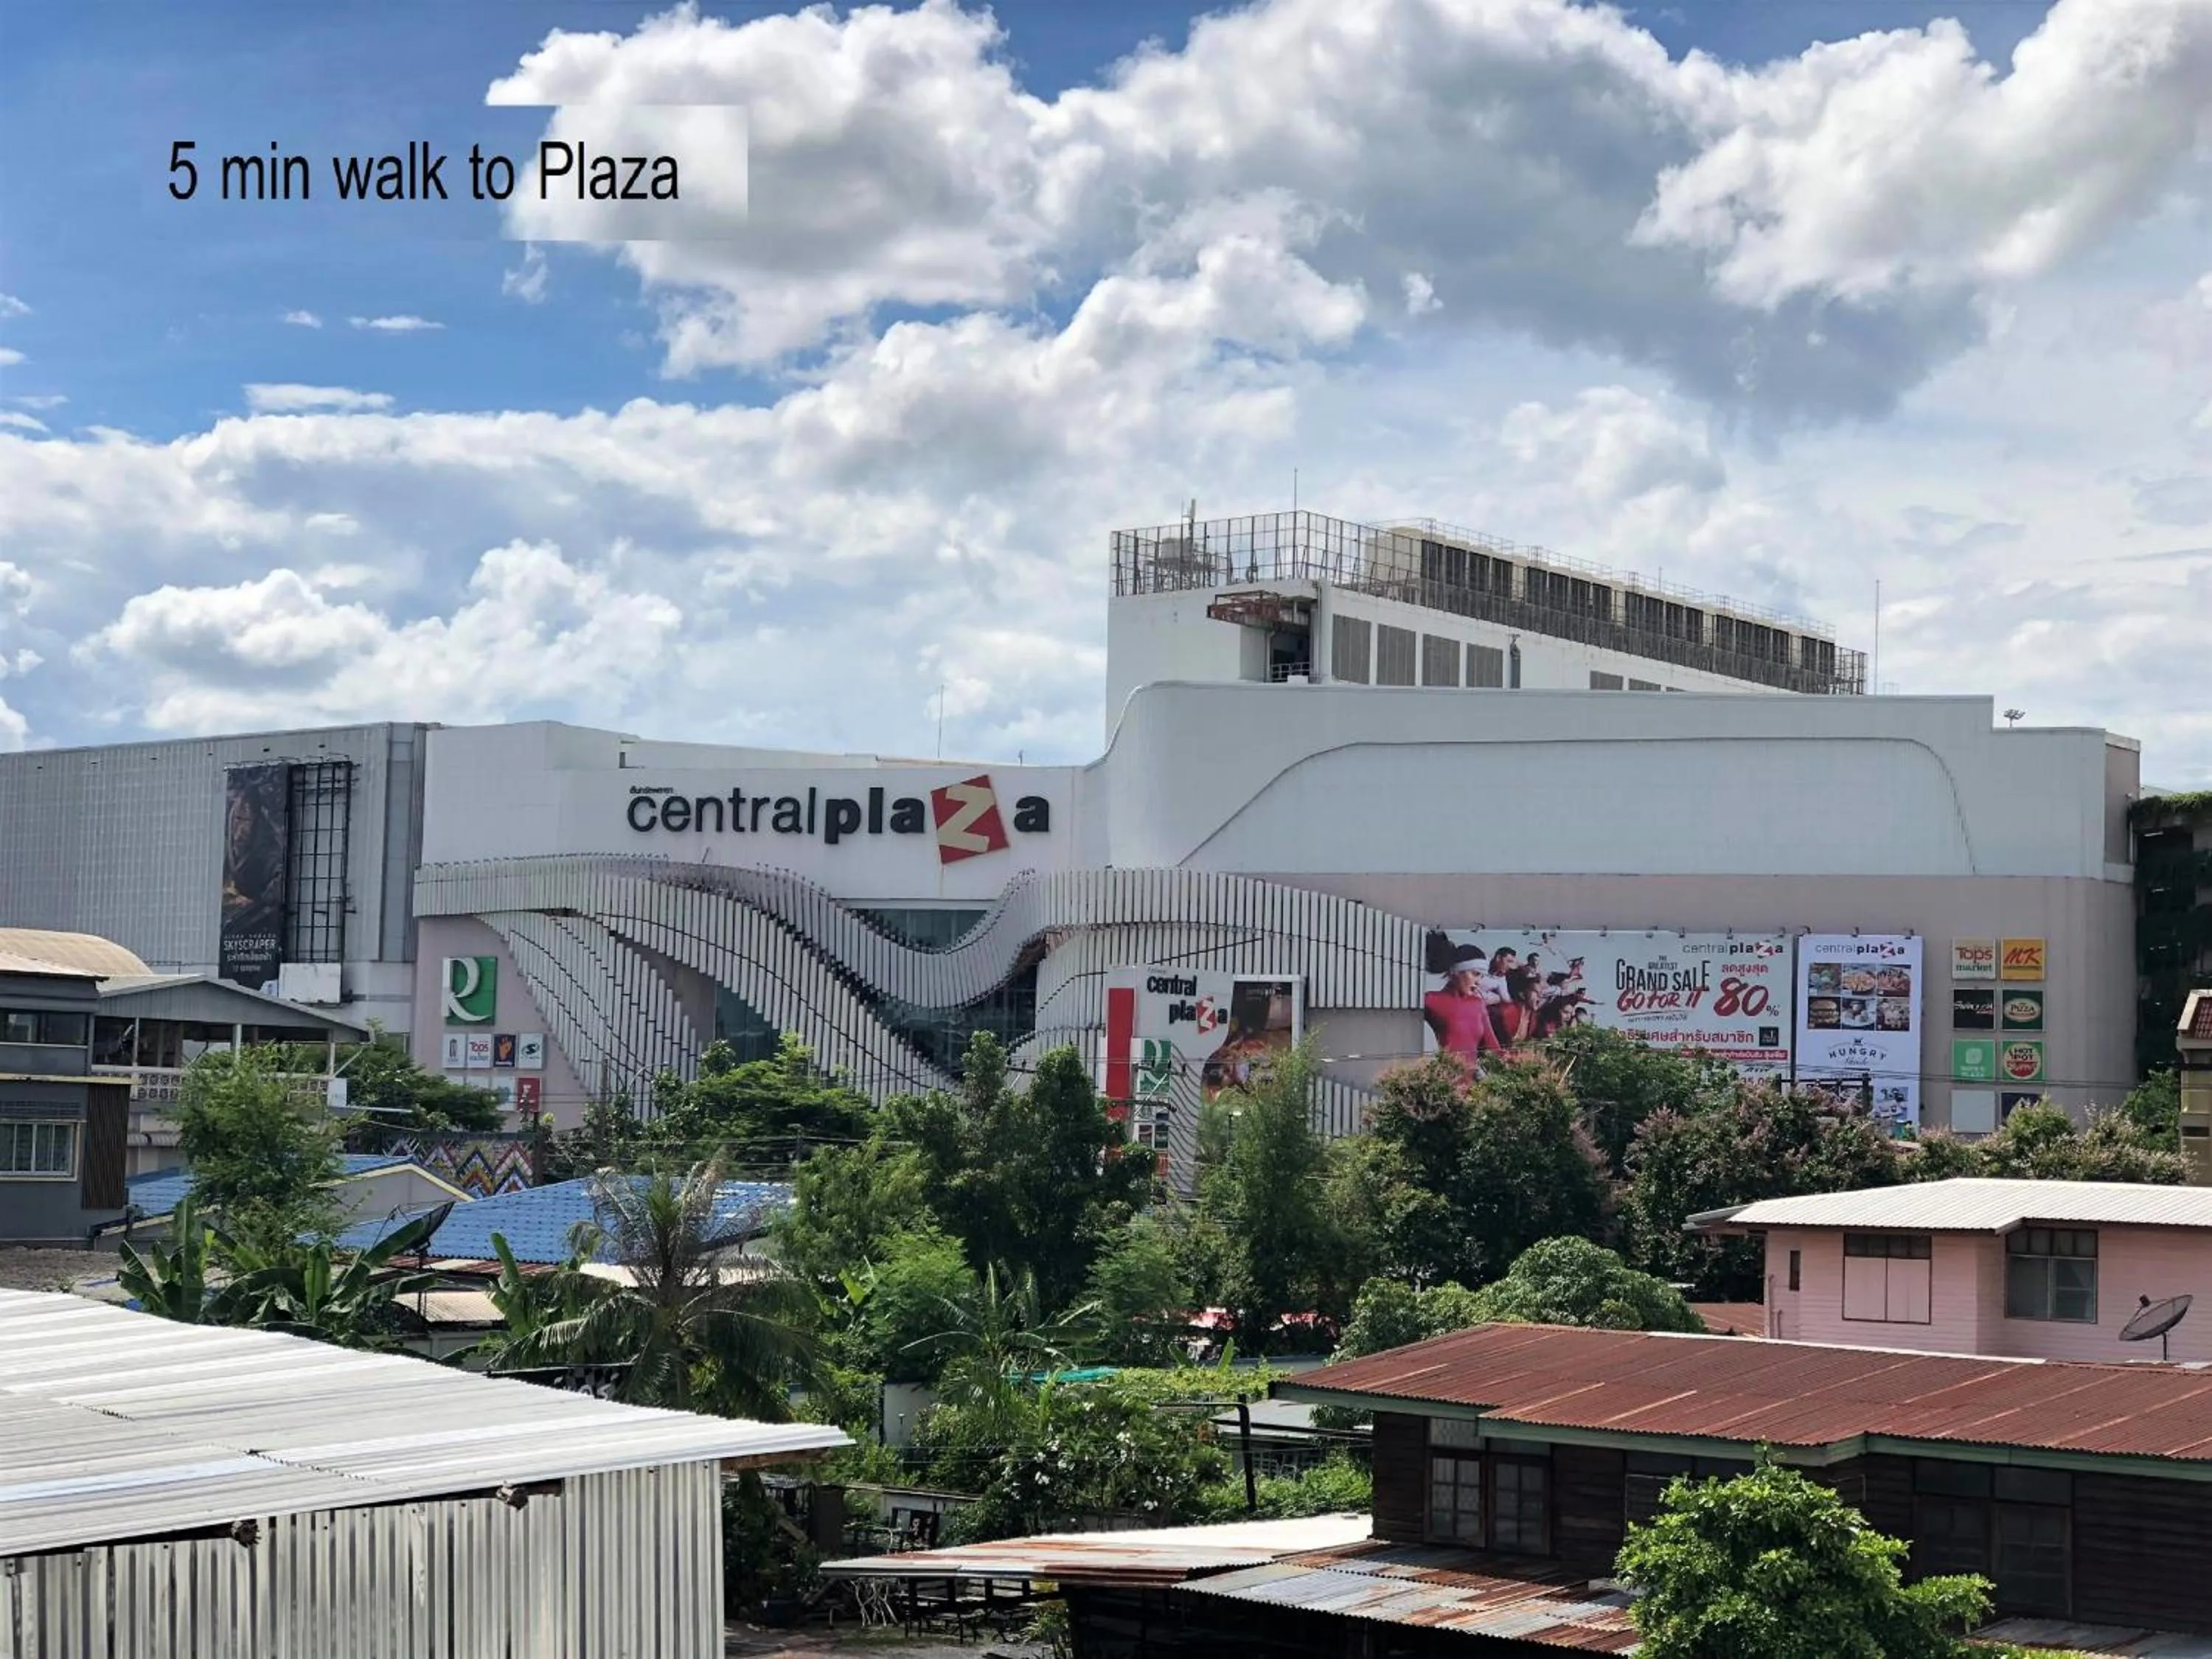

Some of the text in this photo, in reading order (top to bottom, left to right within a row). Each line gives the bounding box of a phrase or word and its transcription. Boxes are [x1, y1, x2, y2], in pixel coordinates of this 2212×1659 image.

[1955, 946, 1993, 964] Tops
[1147, 975, 1197, 996] central
[1615, 959, 1711, 992] GRAND SALE
[442, 957, 493, 1022] R
[1617, 988, 1646, 1012] GO
[1829, 1048, 1887, 1060] HUNGRY
